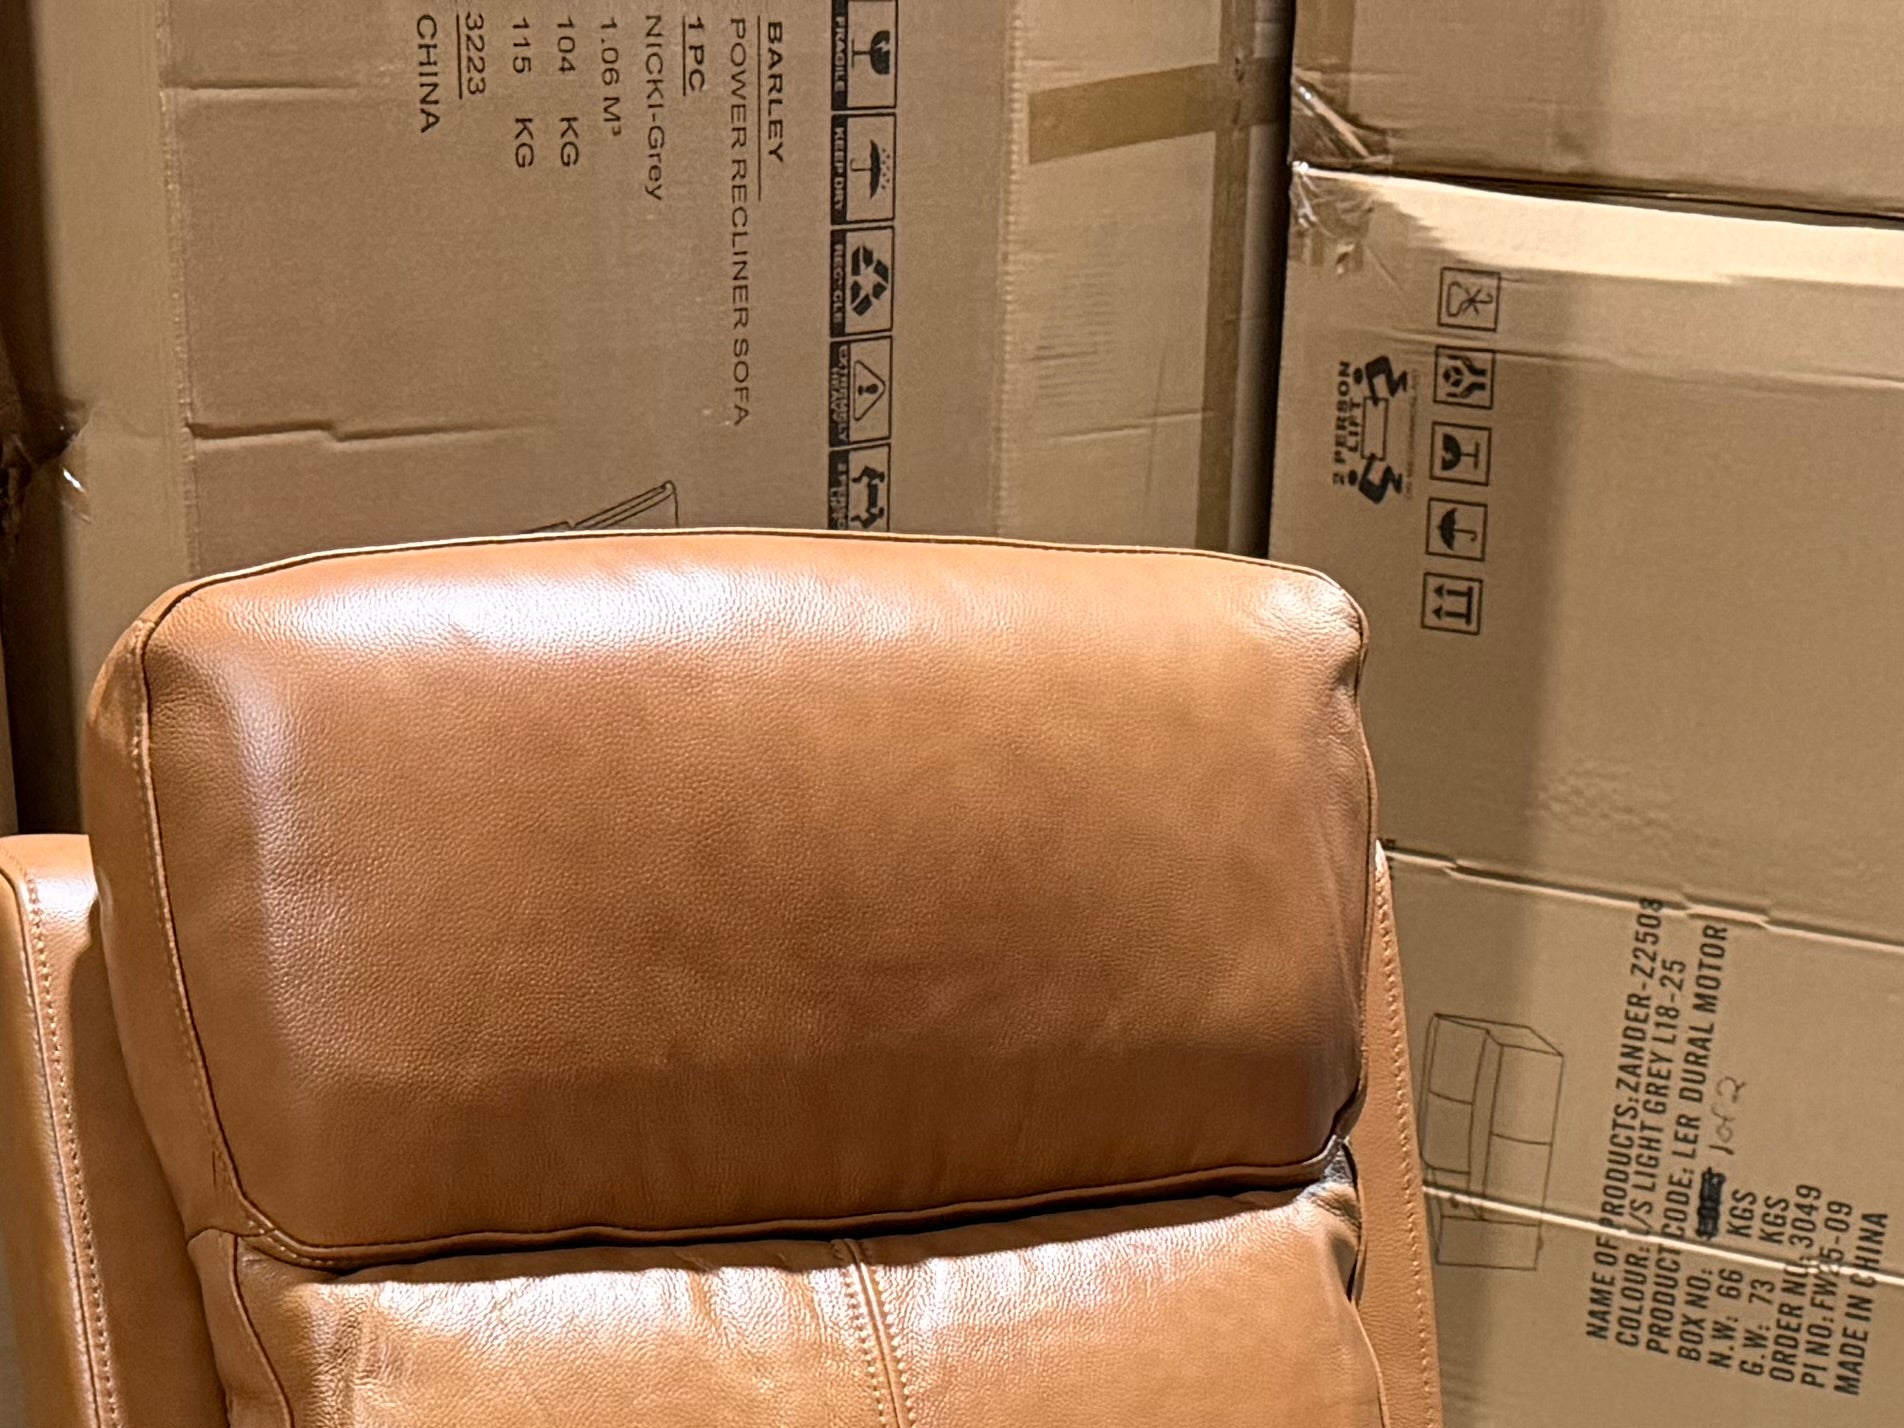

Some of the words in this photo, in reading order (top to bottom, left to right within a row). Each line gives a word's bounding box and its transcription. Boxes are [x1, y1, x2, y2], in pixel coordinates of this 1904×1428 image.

[465, 12, 487, 95] 3223
[512, 17, 532, 75] 115
[556, 16, 576, 73] 104
[600, 17, 621, 86] 1.06
[688, 15, 706, 30] 1
[416, 14, 441, 134] CHINA
[688, 44, 707, 92] PC
[730, 17, 748, 149] POWER
[834, 16, 846, 93] FRAGILE
[645, 14, 666, 201] NICKI-Grey
[767, 21, 784, 163] BARLEY
[514, 117, 535, 169] KG
[559, 116, 580, 168] KG
[834, 127, 846, 177] KEEP
[834, 178, 845, 211] DRY
[731, 159, 750, 329] RECLINER
[733, 338, 750, 427] SOFA
[1334, 361, 1352, 464] PERSON
[1347, 397, 1362, 453] LIFT
[1692, 924, 1728, 1014] MOTOR
[1652, 958, 1687, 1046] L18-25
[1643, 1053, 1674, 1115] GREY
[1679, 1023, 1715, 1104] DURAL
[1631, 1121, 1665, 1193] LIGHT
[1672, 1114, 1701, 1159] LER
[1661, 1167, 1695, 1239] CODE:
[1727, 1188, 1757, 1238] KGS
[1758, 1195, 1789, 1245] KGS
[1594, 1233, 1621, 1267] OF
[1849, 1212, 1889, 1289] CHINA
[1586, 1271, 1615, 1340] NAME
[1615, 1246, 1650, 1347] COLOUR:
[1646, 1243, 1682, 1355] PRODUCT
[1685, 1267, 1714, 1309] NO:
[1716, 1268, 1744, 1299] 66
[1748, 1278, 1776, 1306] 73
[1769, 1302, 1804, 1383] ORDER
[1788, 1184, 1822, 1248] 3049
[1844, 1294, 1875, 1323] IN
[1677, 1313, 1707, 1362] BOX
[1707, 1315, 1739, 1369] N.W:
[1739, 1324, 1771, 1376] G.W:
[1833, 1327, 1869, 1396] MADE
[1801, 1362, 1828, 1389] PI
